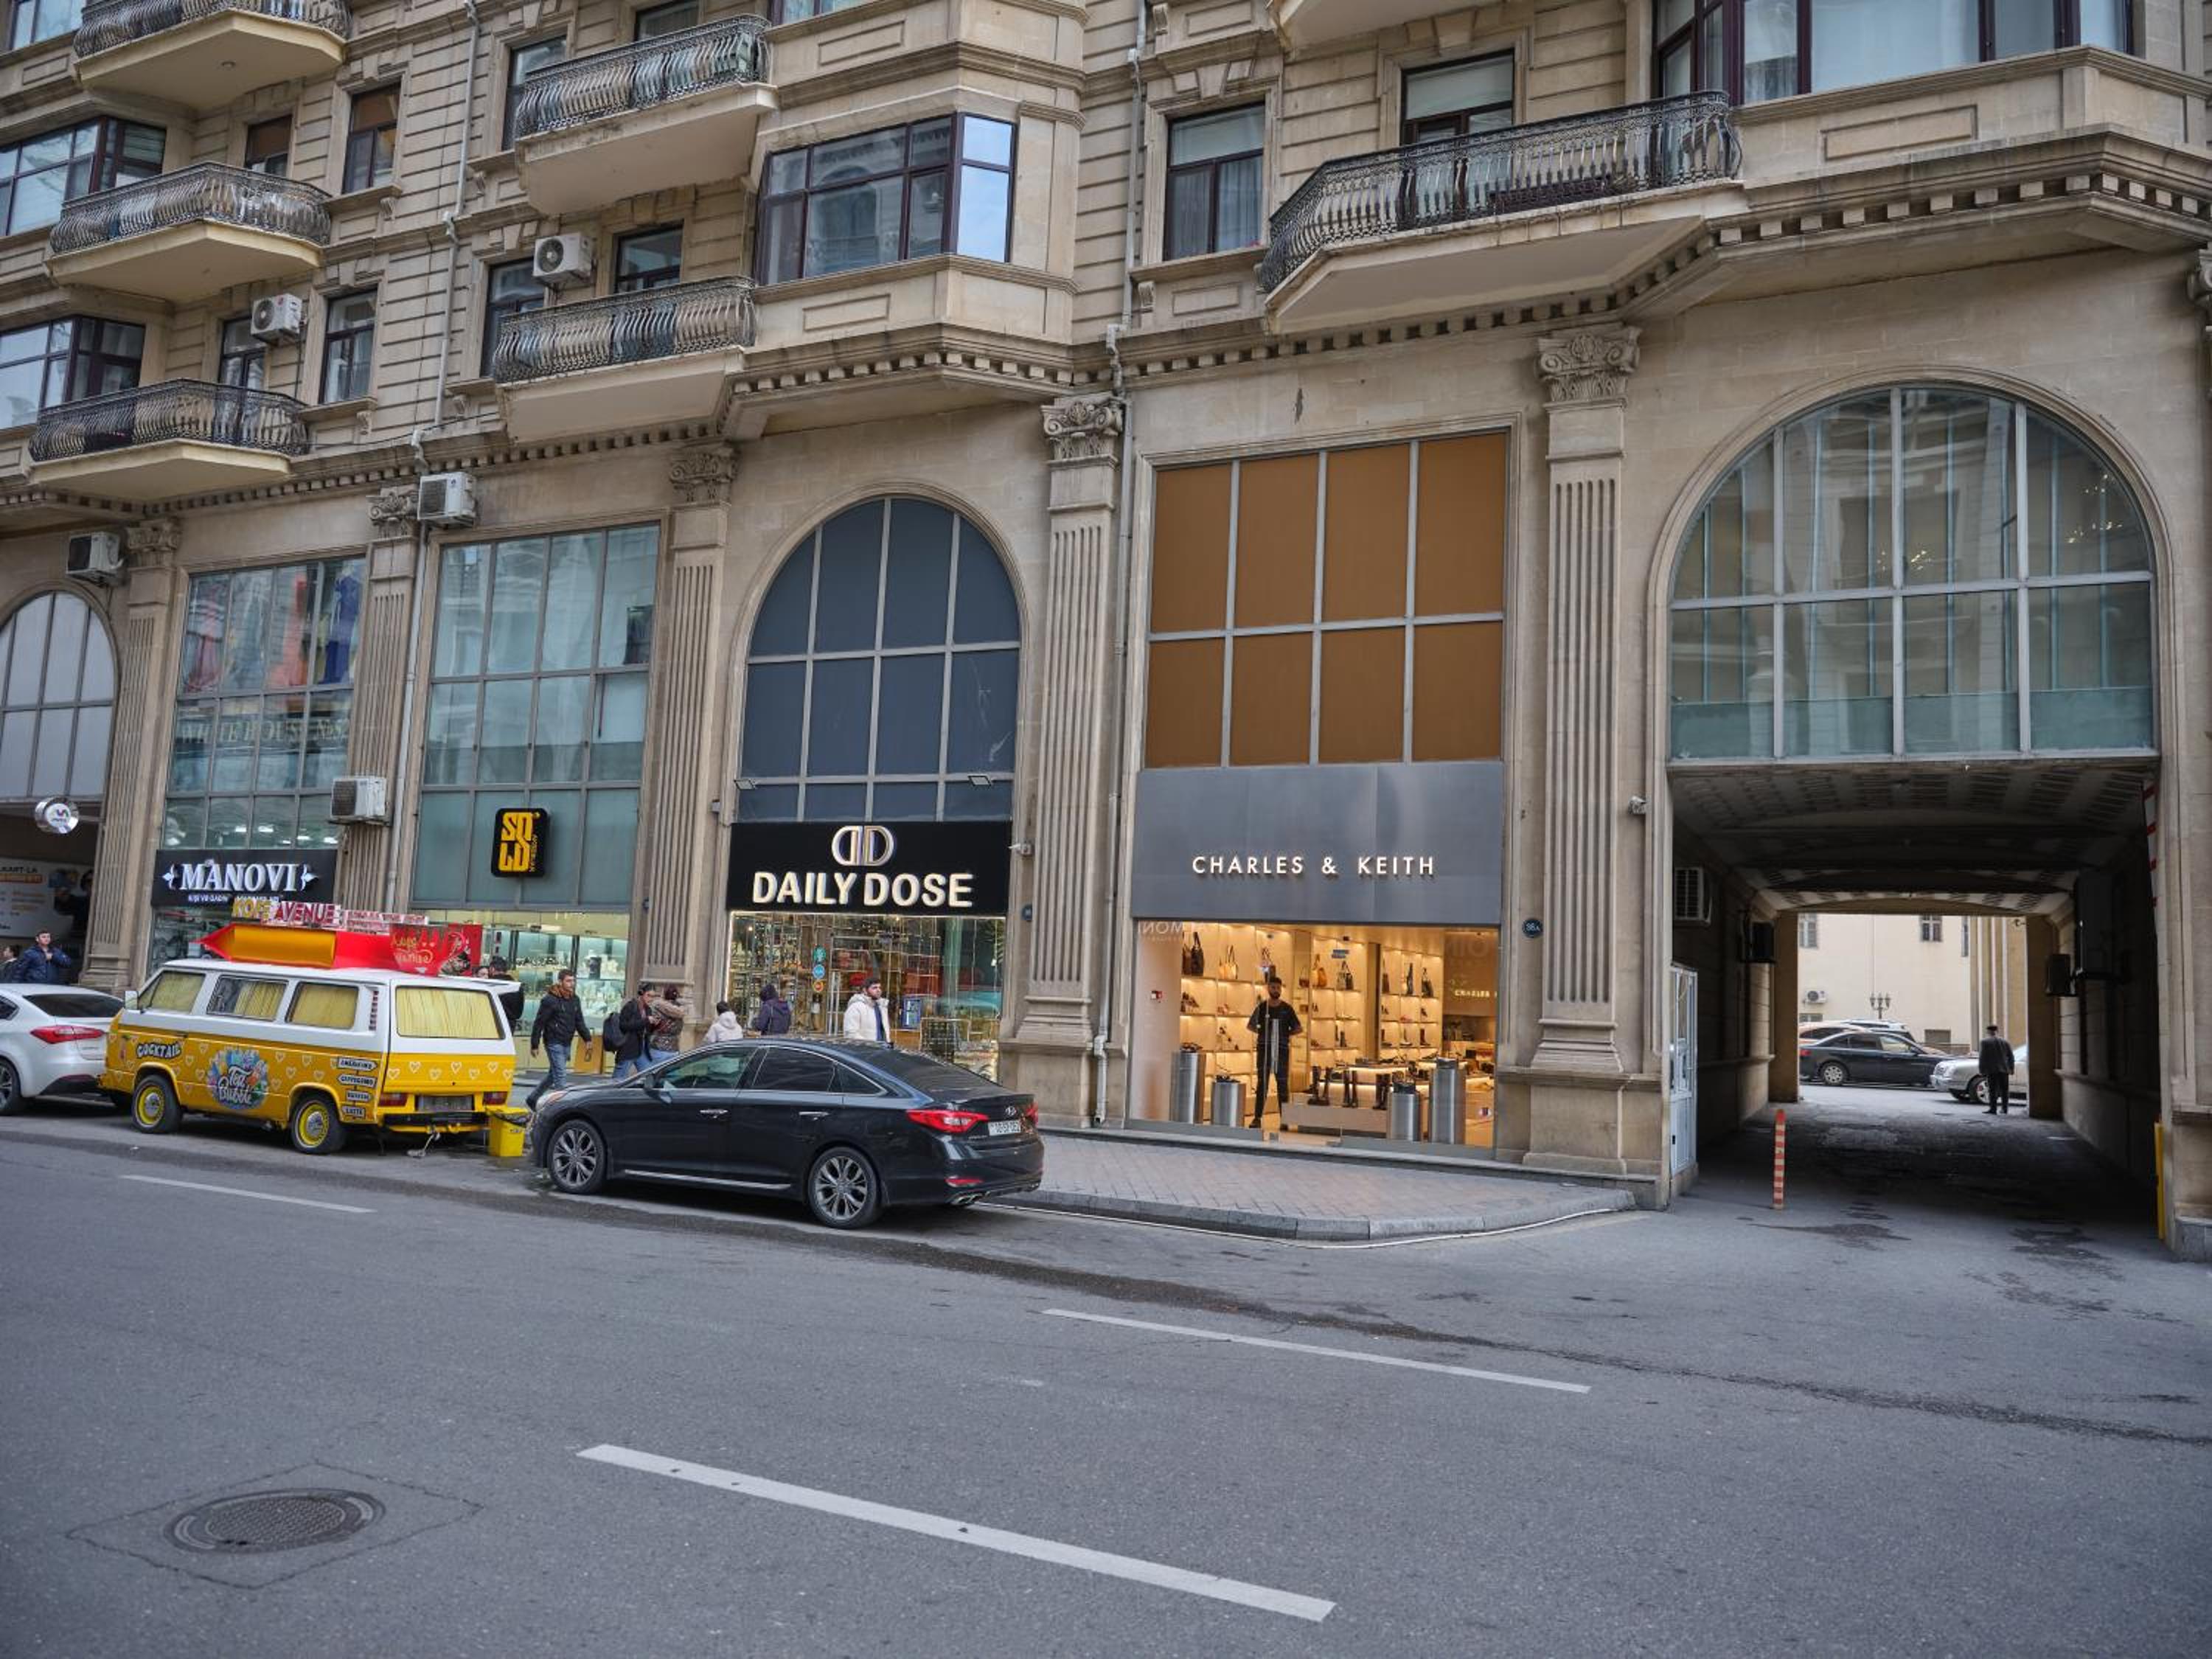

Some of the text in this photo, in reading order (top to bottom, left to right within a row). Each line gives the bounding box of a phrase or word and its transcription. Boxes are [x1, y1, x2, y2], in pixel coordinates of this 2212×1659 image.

[1192, 856, 1433, 875] CHARLES & KEITH
[752, 872, 974, 907] DAILY DOSE
[273, 901, 335, 924] AVENUE
[137, 1041, 181, 1059] COCKTAIL
